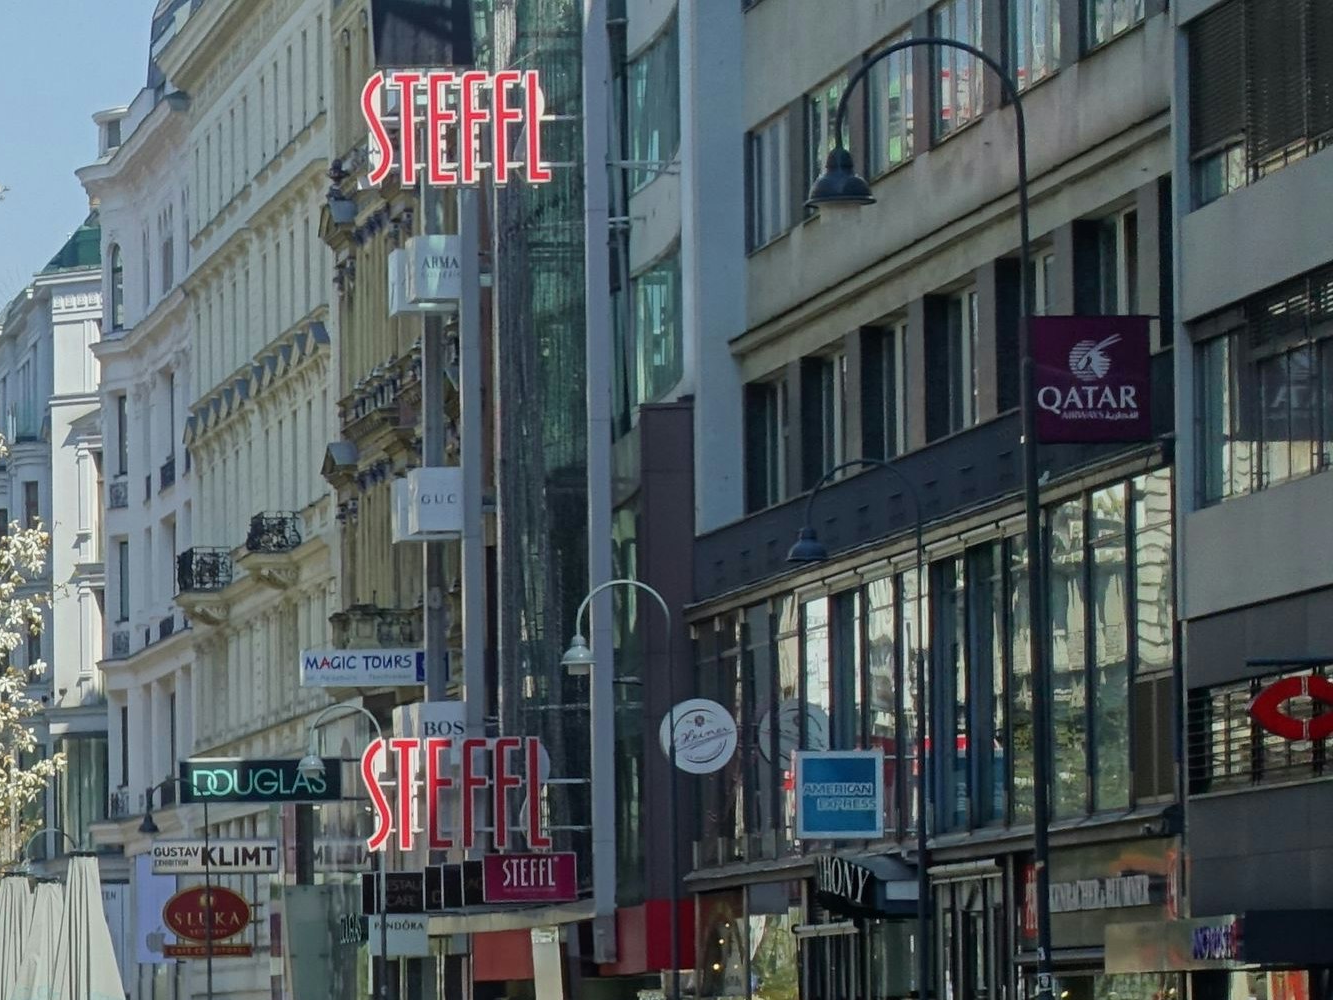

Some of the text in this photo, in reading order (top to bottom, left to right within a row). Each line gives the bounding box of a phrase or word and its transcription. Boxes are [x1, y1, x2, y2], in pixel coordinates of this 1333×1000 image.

[361, 70, 552, 185] STEFFL
[1037, 386, 1137, 415] QATAR
[305, 654, 412, 671] MAGIC TOURS
[193, 769, 327, 796] DOUGLAS
[361, 737, 553, 851] STEFFL
[804, 783, 873, 796] AMERICAN
[817, 800, 877, 811] EXPRESS
[154, 847, 277, 866] GUSTAV KLIMT
[502, 857, 557, 887] STEFFL
